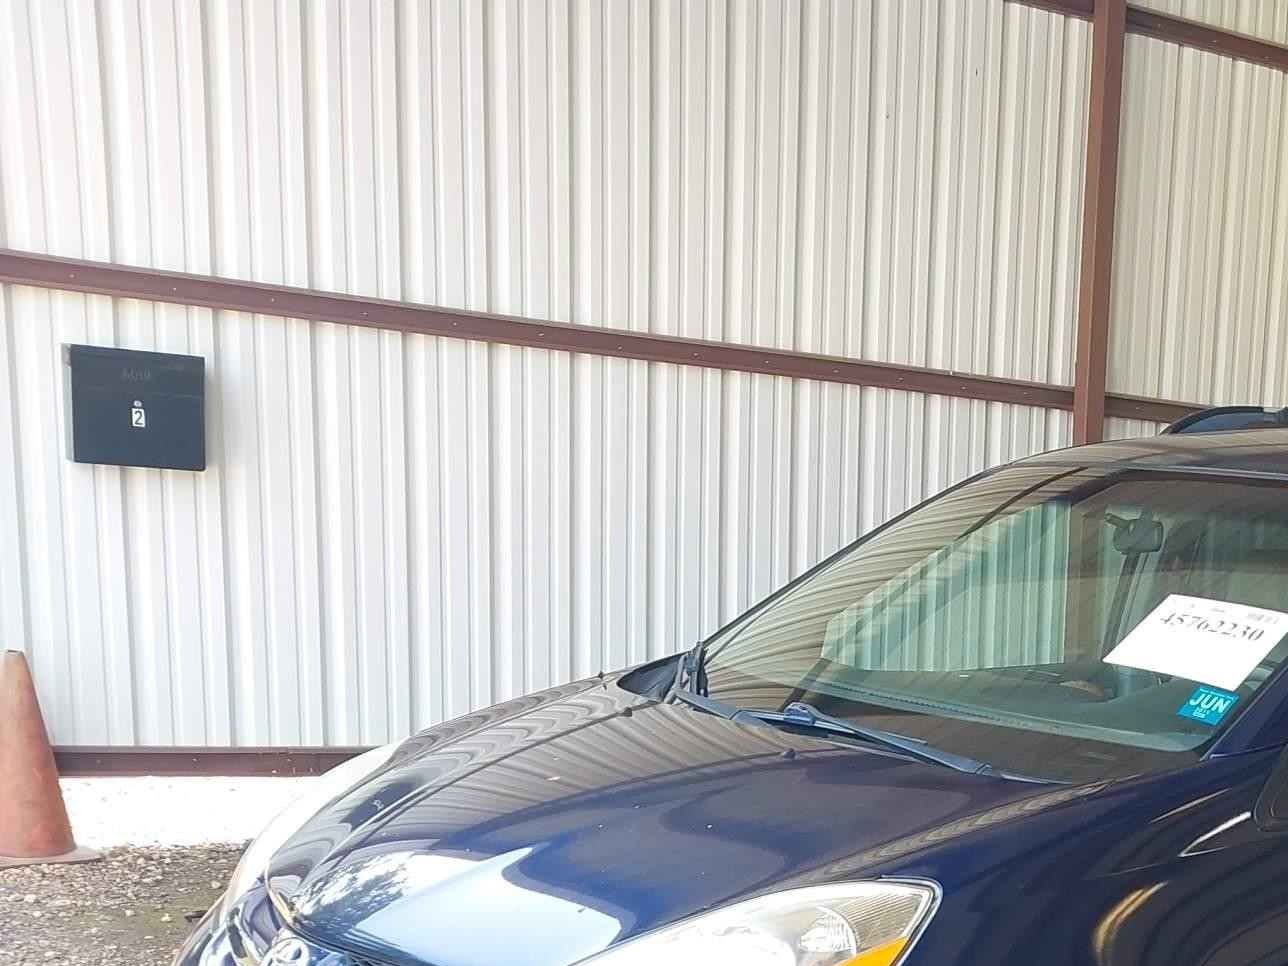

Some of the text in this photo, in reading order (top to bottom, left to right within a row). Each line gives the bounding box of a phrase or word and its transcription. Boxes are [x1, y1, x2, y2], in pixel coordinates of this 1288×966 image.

[134, 410, 144, 426] 2
[1160, 612, 1265, 641] 45762230
[1189, 693, 1231, 714] JUN
